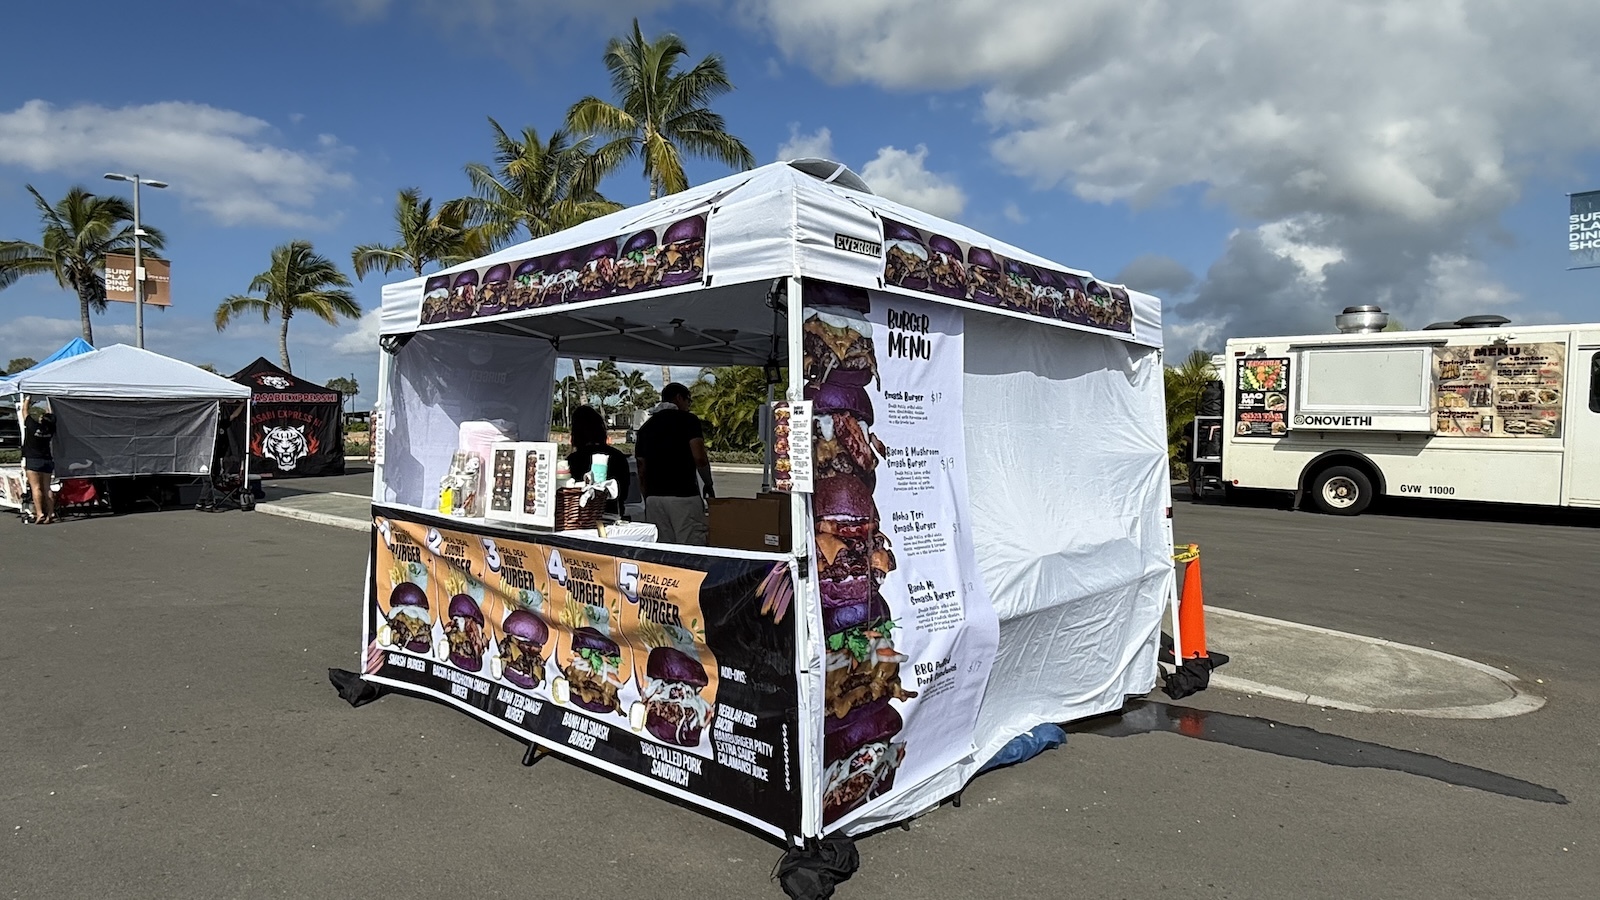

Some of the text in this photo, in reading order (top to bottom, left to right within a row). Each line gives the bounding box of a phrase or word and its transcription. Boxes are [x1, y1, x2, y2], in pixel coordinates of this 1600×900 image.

[1569, 230, 1600, 241] DIN
[105, 273, 130, 281] PLAY
[105, 279, 129, 287] DINE
[888, 308, 930, 336] BURGER
[888, 331, 931, 360] MENU
[1474, 347, 1520, 357] MENU
[251, 392, 338, 403] ASABIEXPRESSHI
[904, 391, 924, 402] Burger
[277, 410, 313, 423] EXPRESS
[886, 446, 904, 457] Bacon
[911, 447, 940, 457] Mushroom
[887, 458, 927, 469] Smash Burger
[1400, 485, 1455, 495] GVW 11000
[892, 510, 924, 521] Aloha Teri
[894, 521, 936, 534] Smash Burger
[427, 527, 442, 558] 2
[482, 539, 501, 573] 3
[497, 546, 528, 558] MEAL DEAL
[548, 549, 568, 587] 4
[563, 557, 600, 571] MEAL DEAL
[500, 566, 535, 592] BURGER
[619, 562, 640, 604] 5
[640, 573, 680, 588] MEAL DEAL
[907, 580, 935, 594] Banh Mi
[566, 579, 605, 609] BURGER
[641, 583, 669, 601] DOUBLE
[910, 590, 956, 605] Smash Burger
[638, 597, 682, 629] BURGER
[388, 653, 426, 672] SMASH BURGER
[914, 661, 933, 676] BBQ
[432, 664, 447, 679] BACON
[473, 678, 490, 695] SMASH
[720, 665, 747, 684] ADD-ONS:
[451, 682, 468, 700] BURGER
[497, 688, 543, 715] ALOHA TERI SMASH
[505, 705, 525, 724] BURGER
[718, 703, 757, 728] REGULAR FRIES
[562, 711, 610, 741] BANH MI SMASH
[714, 716, 734, 733] BACON
[568, 729, 596, 751] BURGER
[714, 728, 773, 758] HAMBURGER PATTY
[640, 741, 702, 775] BBQ PULLED PORK
[715, 741, 757, 764] EXTRA SAUCE
[651, 759, 689, 787] SANDWICH
[752, 764, 769, 782] JUICE
